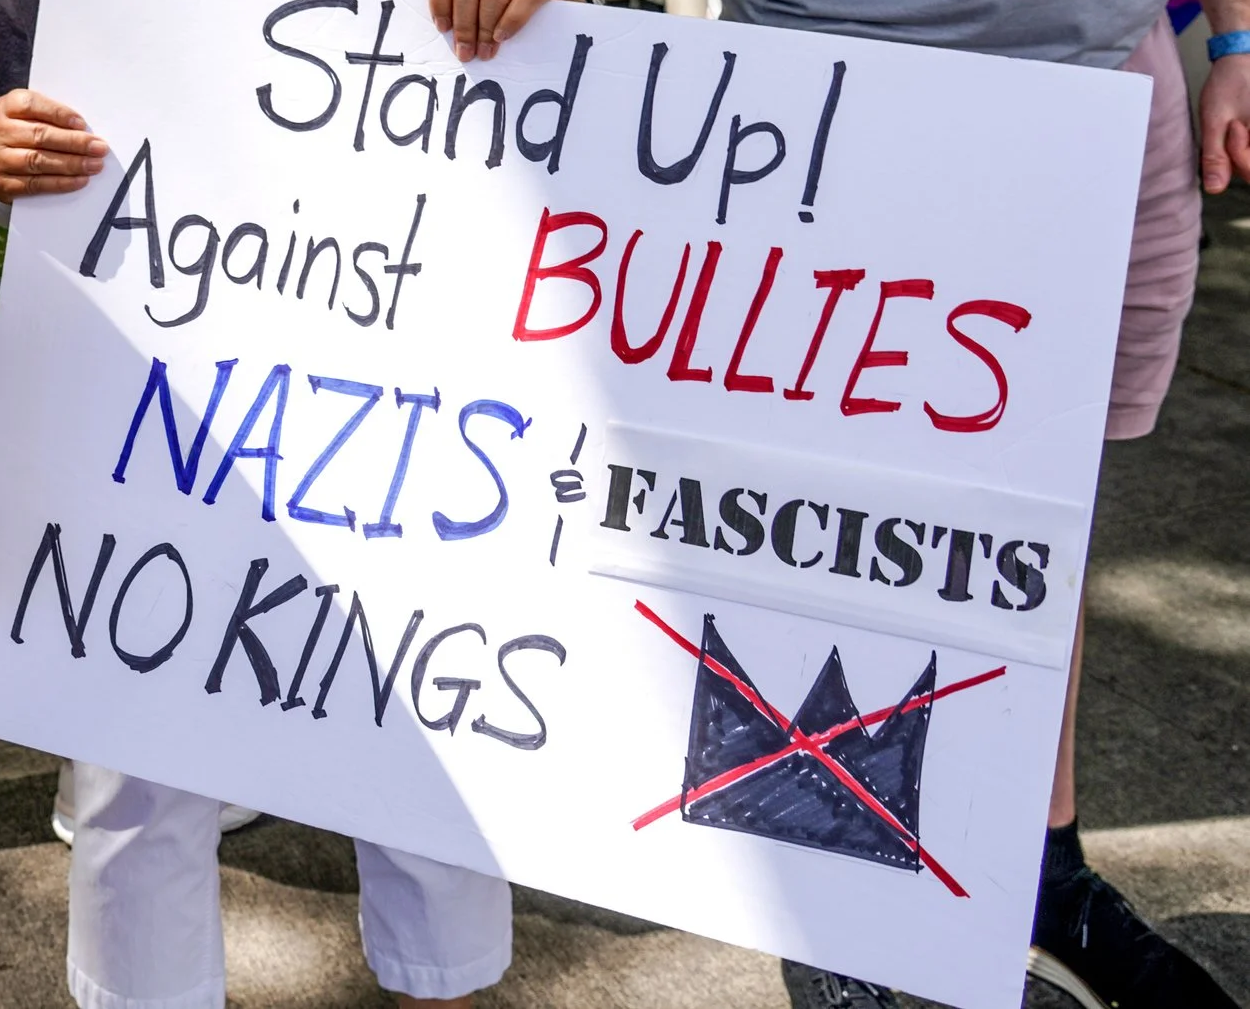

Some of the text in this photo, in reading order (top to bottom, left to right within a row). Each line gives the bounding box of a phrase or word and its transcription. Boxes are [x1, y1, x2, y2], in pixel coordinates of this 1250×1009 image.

[636, 42, 847, 226] Up!
[78, 137, 1033, 433] Against BULLIES
[111, 356, 533, 542] NAZIS
[599, 463, 1051, 612] FASCISTS
[10, 522, 567, 750] NO KINGS
